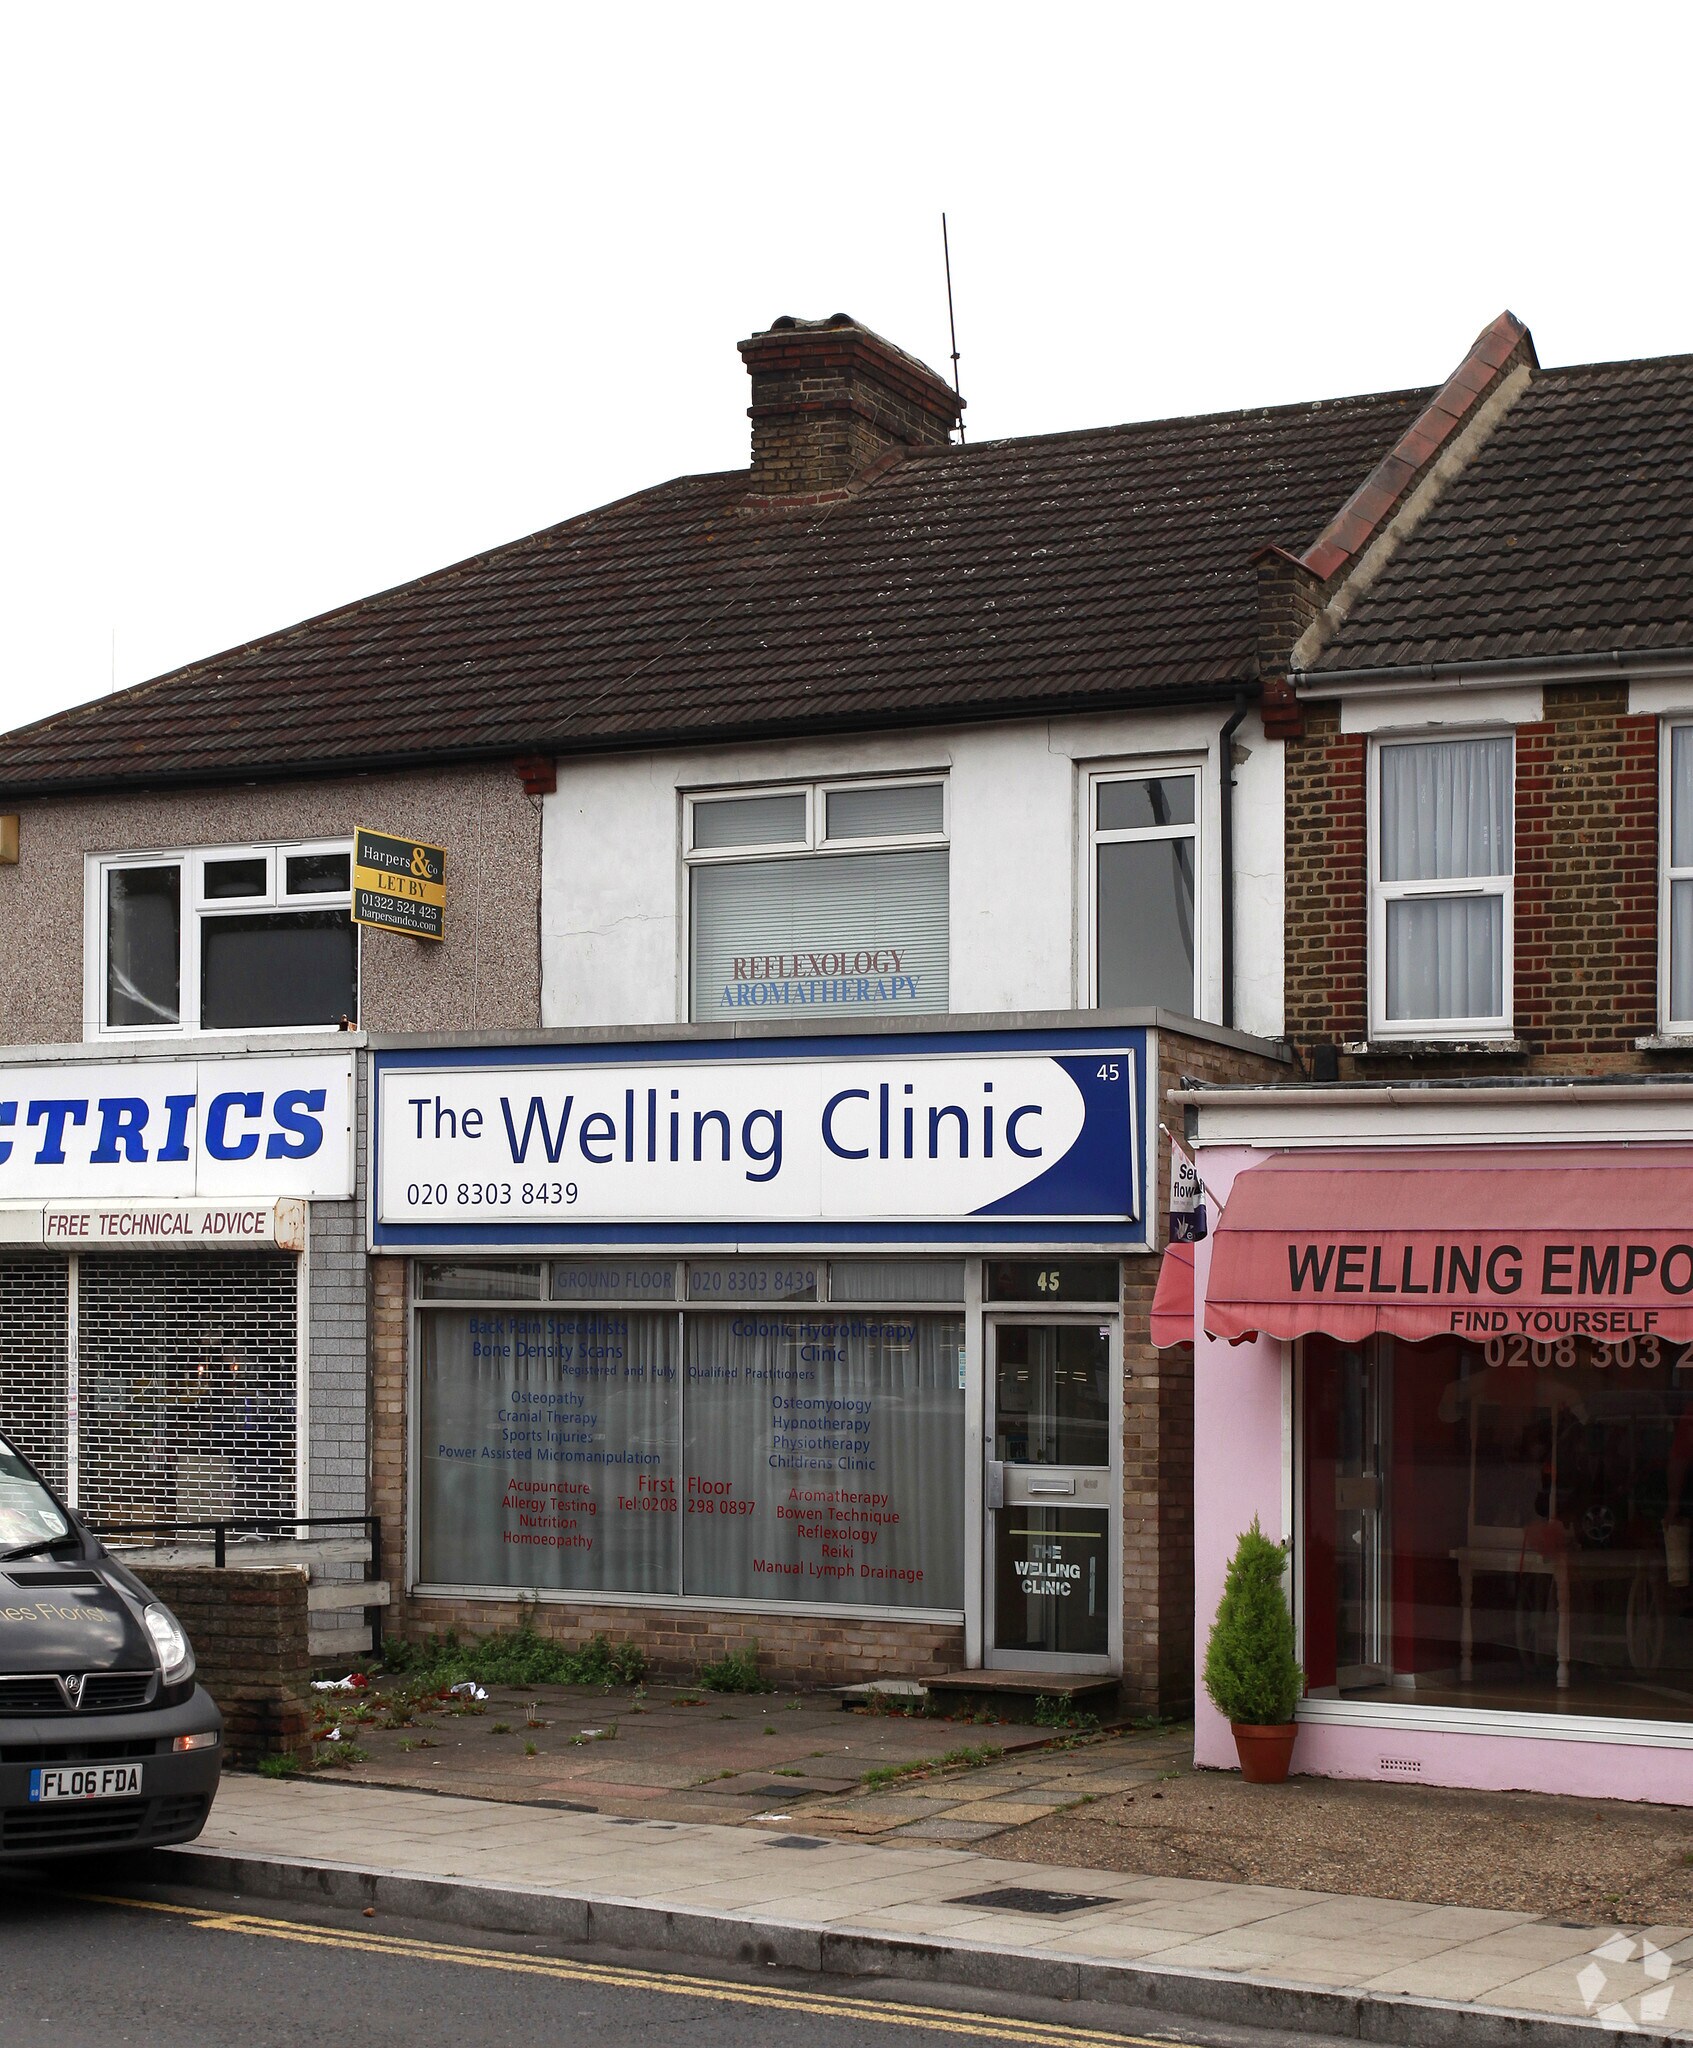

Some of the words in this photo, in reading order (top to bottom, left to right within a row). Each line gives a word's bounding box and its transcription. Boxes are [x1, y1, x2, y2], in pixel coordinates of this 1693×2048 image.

[378, 873, 406, 892] LET
[409, 880, 427, 897] BY
[361, 893, 394, 911] 01322
[396, 901, 416, 915] 524
[419, 905, 437, 919] 425
[361, 906, 436, 931] harpersandco.com
[732, 950, 905, 980] REFLEXOLOGY
[720, 976, 920, 1007] AROMATHERAPY
[1096, 1063, 1120, 1082] 45
[408, 1096, 484, 1139] The
[500, 1089, 783, 1182] Welling
[821, 1082, 1043, 1160] Clinic
[407, 1183, 448, 1205] 020
[457, 1183, 512, 1205] 8303
[521, 1182, 578, 1204] 8439
[47, 1213, 91, 1236] FREE
[99, 1212, 193, 1236] TECHNICAL
[201, 1211, 267, 1235] ADVICE
[1287, 1244, 1523, 1294] WELLING
[557, 1271, 620, 1288] GROUND
[625, 1271, 672, 1288] FLOOR
[693, 1271, 721, 1290] 020
[728, 1271, 768, 1290] 8303
[774, 1271, 815, 1290] 8439
[1037, 1271, 1060, 1291] 45
[469, 1318, 504, 1334] Back
[509, 1318, 541, 1334] Pain
[547, 1318, 628, 1338] Specialists
[732, 1319, 793, 1337] Colonic
[800, 1320, 917, 1342] Hydrotherapy
[1450, 1311, 1509, 1333] FIND
[1516, 1311, 1659, 1333] YOURSELF
[473, 1341, 511, 1358] Bone
[516, 1342, 573, 1361] Density
[579, 1343, 623, 1359] Scans
[800, 1345, 846, 1362] Clinic
[1484, 1335, 1577, 1367] 0208
[1590, 1335, 1661, 1368] 303
[562, 1364, 617, 1378] Registered
[623, 1365, 644, 1376] and
[652, 1365, 676, 1379] Fully
[688, 1366, 738, 1379] Qualified
[745, 1367, 815, 1380] Practitioners
[511, 1390, 585, 1407] Osteopathy
[772, 1396, 872, 1413] Osteomyology
[498, 1409, 542, 1423] Cranial
[547, 1410, 598, 1427] Therapy
[772, 1416, 871, 1434] Hypnotherapy
[502, 1428, 542, 1442] Sports
[547, 1429, 593, 1445] Injuries
[773, 1436, 870, 1452] Physiotherapy
[438, 1445, 476, 1458] Power
[481, 1446, 532, 1460] Assisted
[537, 1448, 661, 1465] Micromanipulation
[768, 1454, 833, 1470] Childrens
[837, 1456, 876, 1471] Clinic
[508, 1478, 590, 1494] Acupuncture
[638, 1475, 675, 1493] First
[688, 1476, 733, 1495] Floor
[502, 1496, 546, 1513] Allergy
[550, 1497, 597, 1516] Testing
[617, 1496, 678, 1512] Tel:0208
[687, 1499, 714, 1514] 298
[719, 1500, 756, 1515] 0897
[788, 1488, 889, 1508] Aromatherapy
[519, 1514, 577, 1529] Nutrition
[776, 1505, 823, 1521] Bowen
[828, 1506, 900, 1526] Technique
[503, 1531, 593, 1551] Homoeopathy
[797, 1524, 878, 1544] Reflexology
[821, 1544, 854, 1559] Reiki
[1032, 1544, 1062, 1560] THE
[753, 1559, 804, 1575] Manual
[809, 1562, 855, 1580] Lymph
[860, 1564, 924, 1583] Drainage
[1014, 1560, 1081, 1579] WELLING
[1021, 1579, 1071, 1596] CLINIC
[35, 1603, 112, 1623] Florist
[44, 1771, 97, 1797] FL06
[102, 1768, 138, 1793] FDA
